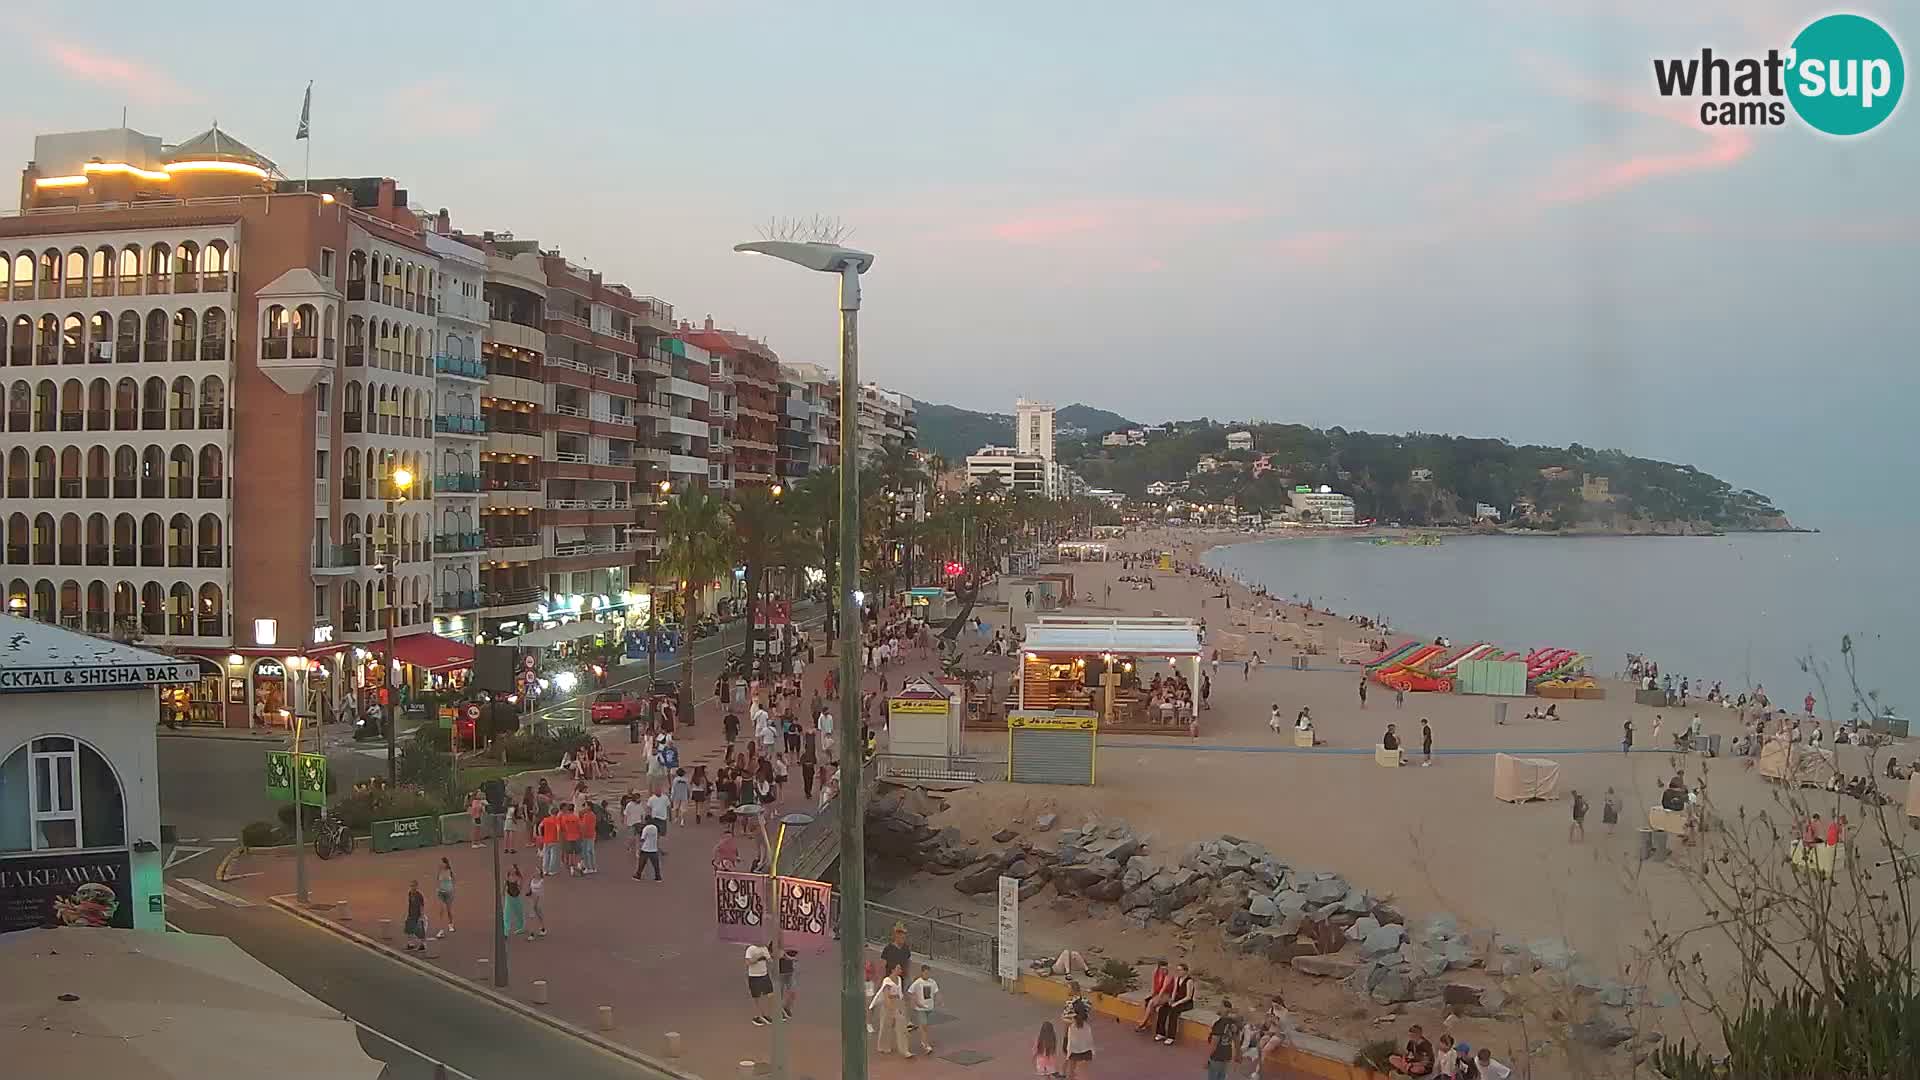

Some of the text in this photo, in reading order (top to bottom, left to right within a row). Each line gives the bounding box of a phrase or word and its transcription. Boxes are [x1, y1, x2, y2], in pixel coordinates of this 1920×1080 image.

[64, 671, 75, 684] &
[80, 668, 141, 684] SHISHA
[146, 667, 179, 681] BAR
[258, 665, 282, 676] KFC
